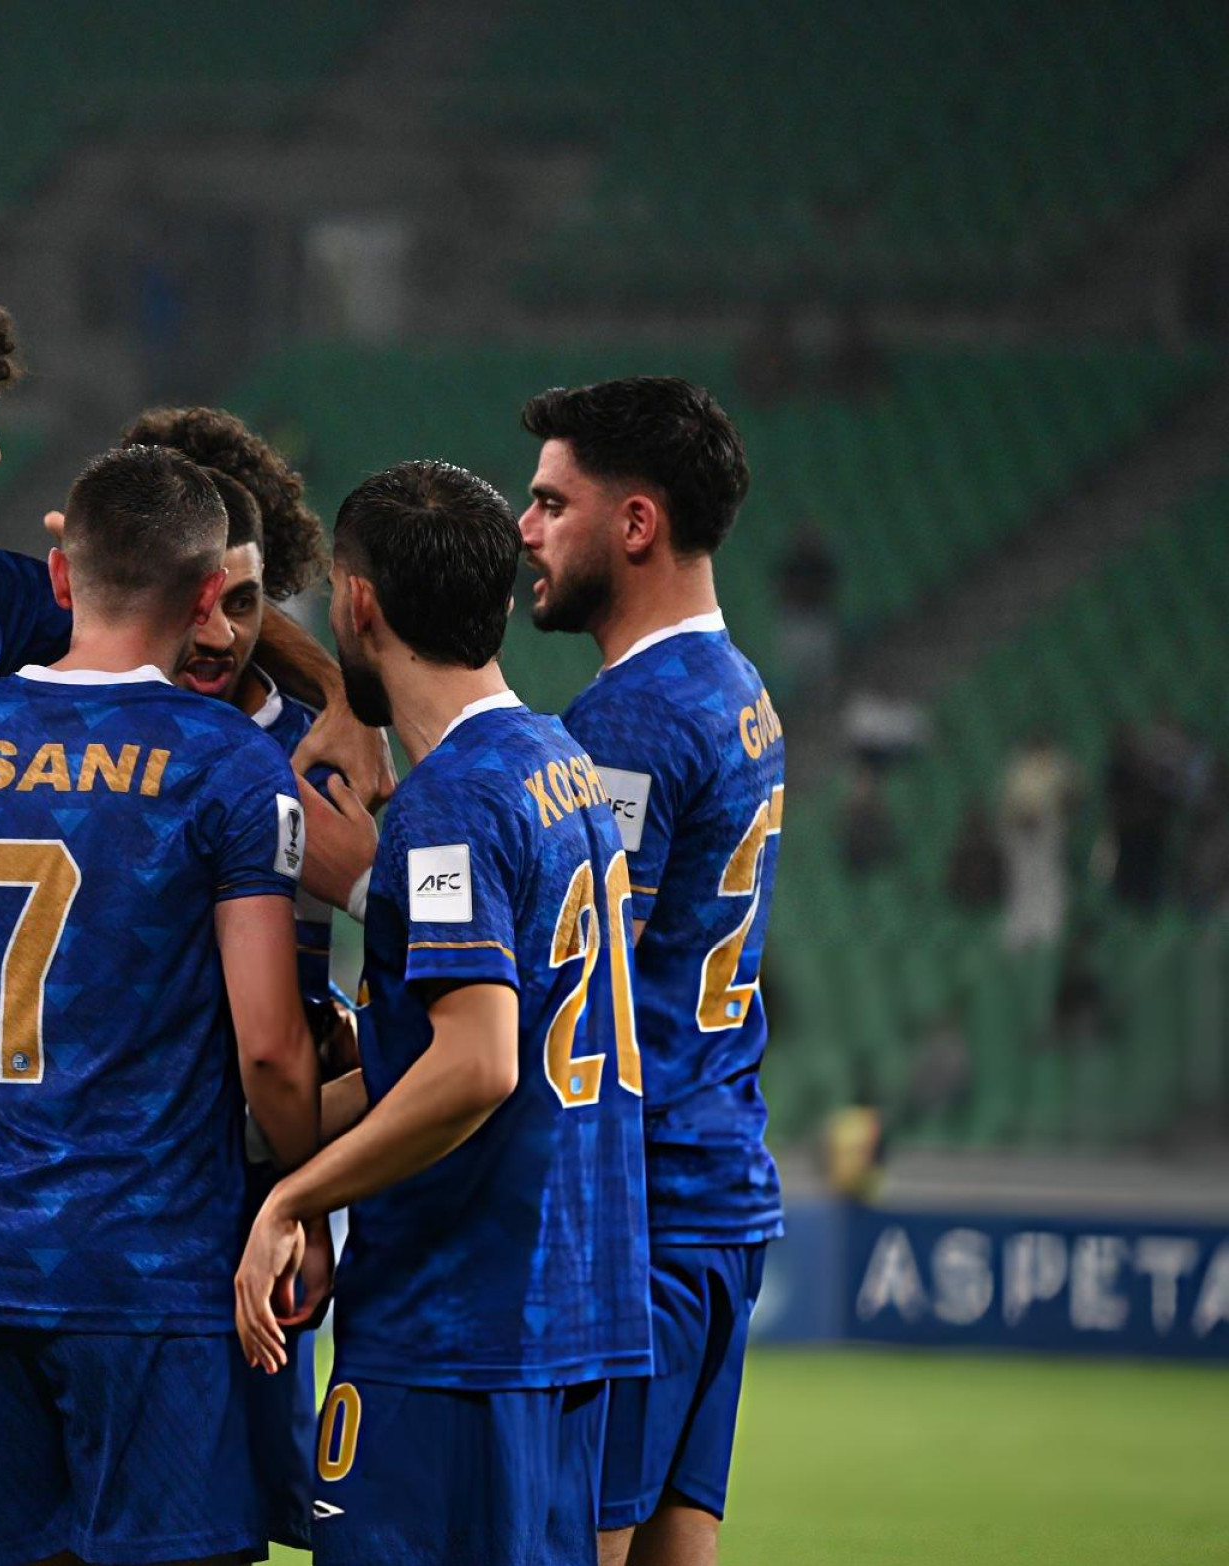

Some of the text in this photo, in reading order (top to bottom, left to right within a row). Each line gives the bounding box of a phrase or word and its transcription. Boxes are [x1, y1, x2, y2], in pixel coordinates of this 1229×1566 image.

[608, 797, 637, 820] FC
[416, 872, 462, 893] AFC
[696, 784, 785, 1033] 2
[856, 1225, 1229, 1338] ASPETA
